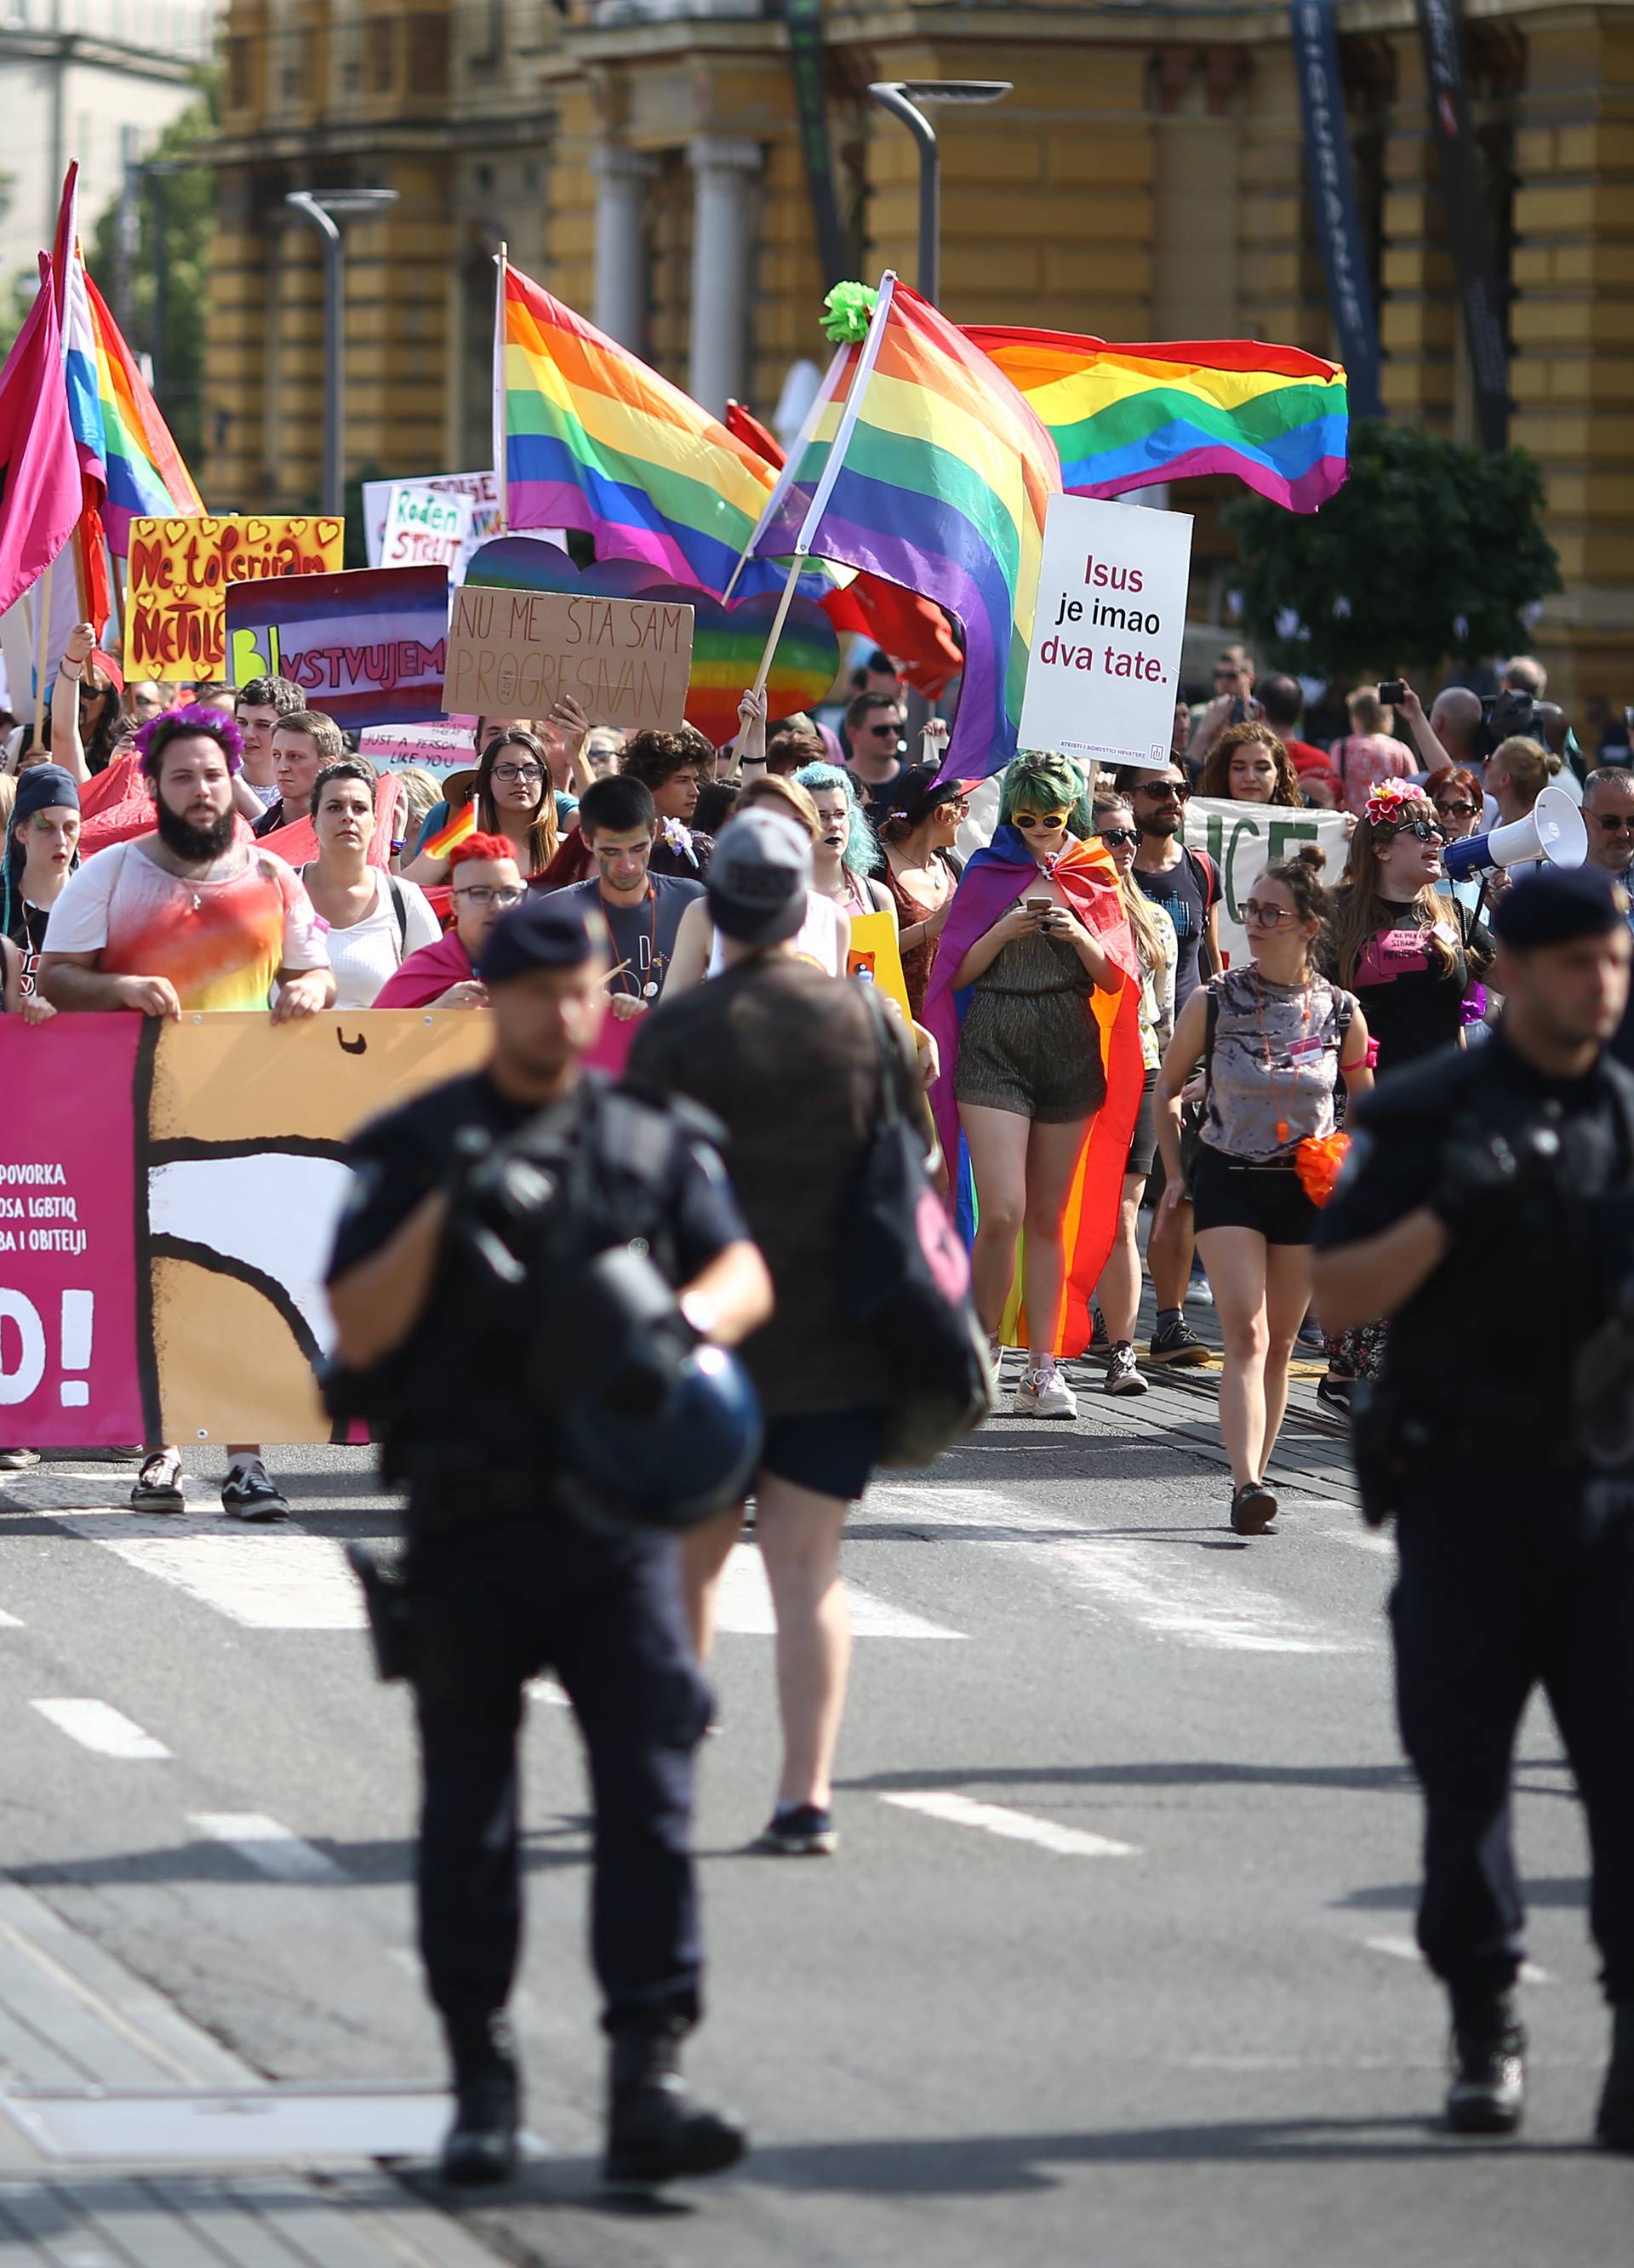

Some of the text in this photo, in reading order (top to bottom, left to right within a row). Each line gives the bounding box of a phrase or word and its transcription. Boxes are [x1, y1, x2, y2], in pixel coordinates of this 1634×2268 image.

[133, 540, 174, 592] Ne
[1083, 554, 1144, 592] Isus
[457, 596, 682, 654] NU ME ŠTA SAM
[1054, 593, 1160, 635] je imao
[1040, 636, 1168, 683] dva tate.
[454, 648, 666, 719] PROGRESIVAN
[363, 734, 457, 751] JUST A PERSON
[390, 751, 454, 768] LIKE YOU
[0, 1163, 67, 1185] POVORKA
[28, 1197, 78, 1222] LGBTIQ
[20, 1230, 26, 1250] I
[29, 1229, 87, 1255] OBITELJI
